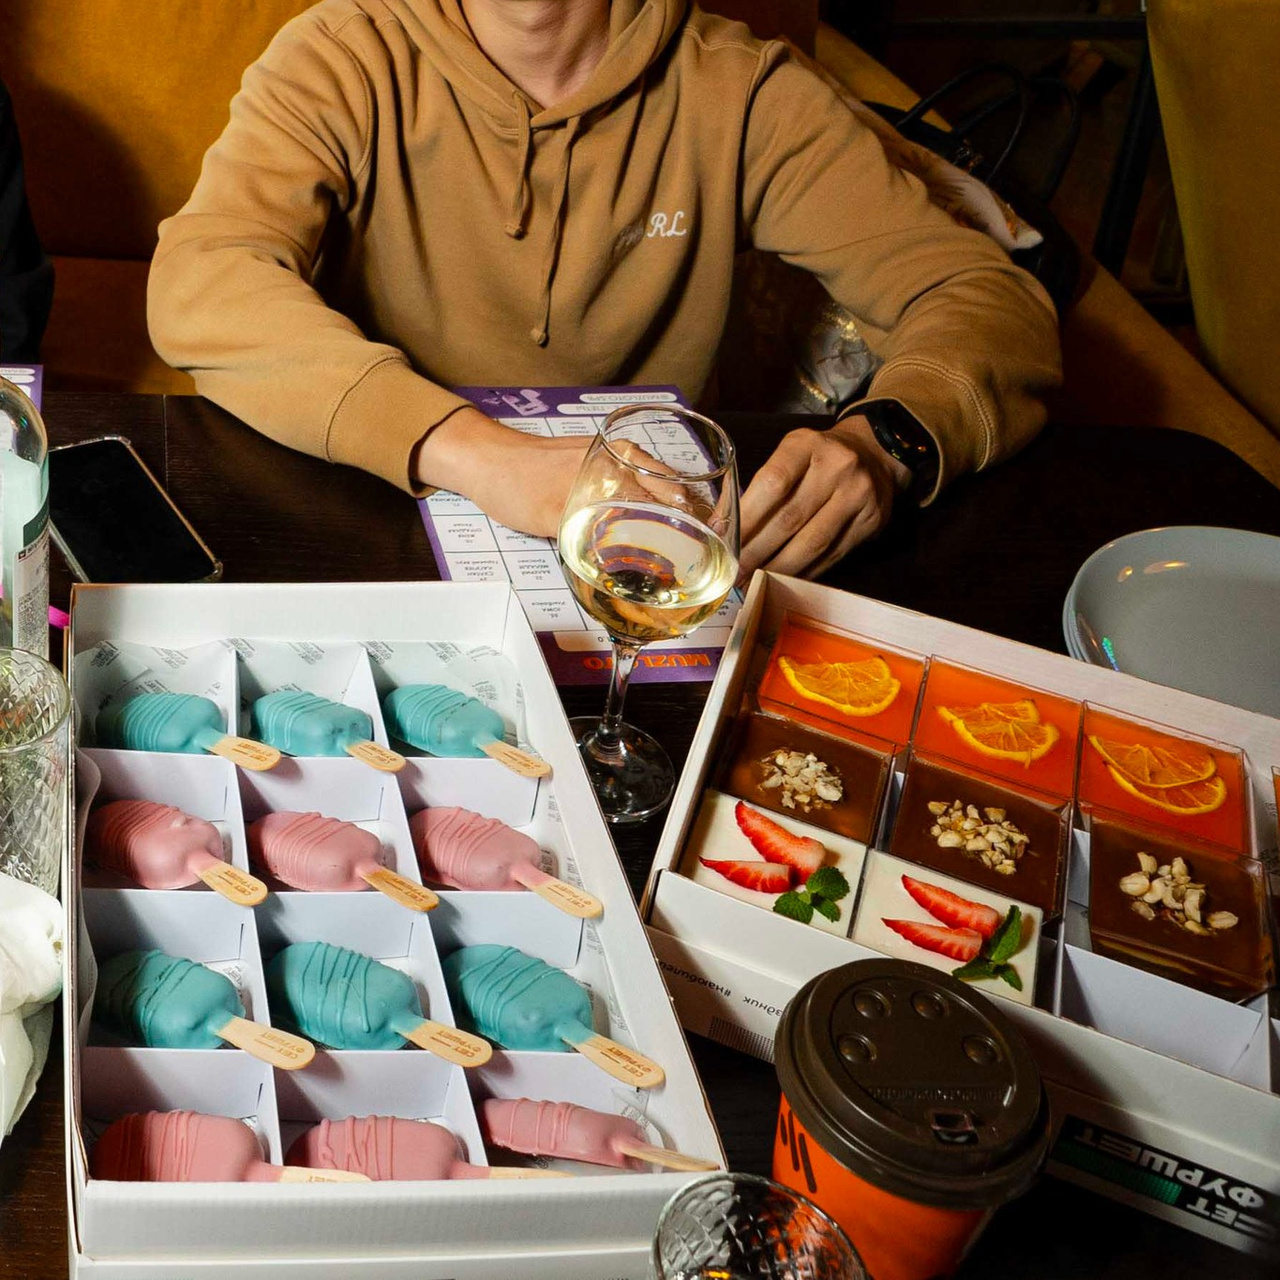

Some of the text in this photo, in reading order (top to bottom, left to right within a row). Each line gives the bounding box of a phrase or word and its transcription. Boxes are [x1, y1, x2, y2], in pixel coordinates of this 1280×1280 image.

[646, 210, 688, 238] RL
[582, 653, 712, 670] MUZLTO
[742, 996, 783, 1017] здник
[1073, 1127, 1265, 1209] ФУРШЕТ
